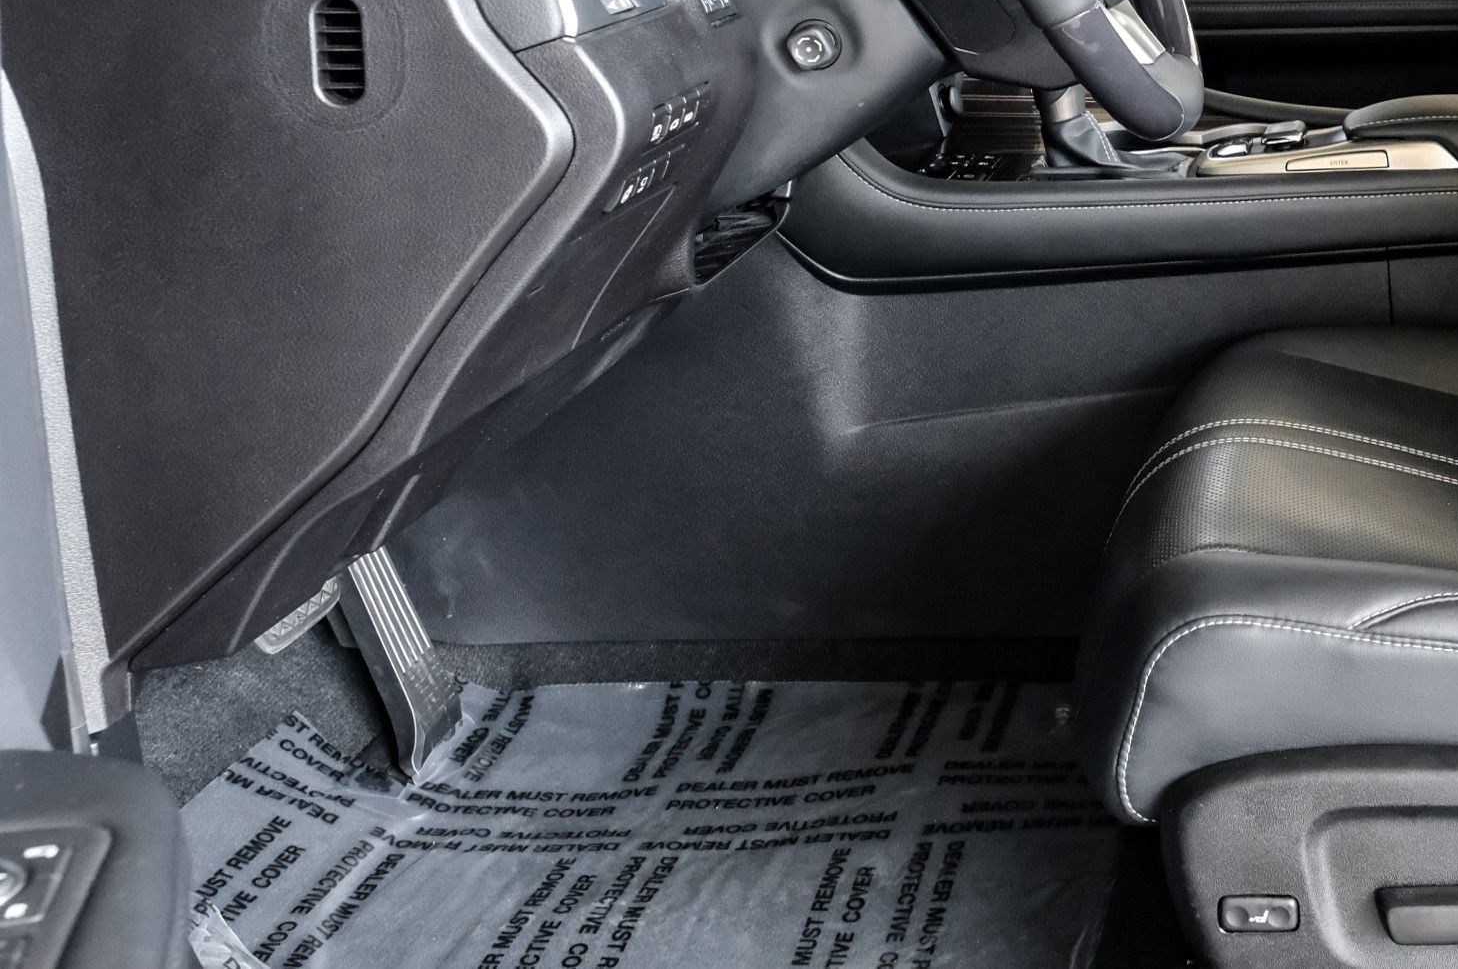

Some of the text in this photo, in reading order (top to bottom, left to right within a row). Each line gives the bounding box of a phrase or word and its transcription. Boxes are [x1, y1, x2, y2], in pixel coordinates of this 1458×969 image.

[506, 695, 534, 735] MUST
[239, 756, 357, 809] PROTECTIV
[279, 739, 345, 783] COVER
[676, 763, 915, 793] DEALER MUST REMOVE
[218, 768, 340, 826] DEALER MU
[405, 792, 616, 818] PROTECTIVE COVER
[418, 781, 660, 802] DEALER MUST REMOVE
[665, 785, 876, 811] PROTECTIVE COVER
[961, 800, 1037, 813] COVER
[225, 815, 292, 871] REMOVE
[415, 827, 632, 840] PROTECTIVE COVER
[533, 840, 621, 852] DEALER
[637, 830, 892, 852] DEALER MUST REMOVE
[682, 811, 898, 836] PROTECTIVE COVER
[921, 819, 1014, 836] REMOVE
[251, 844, 306, 889] COVER
[463, 840, 531, 853] MUST
[553, 874, 598, 914] COVER
[633, 856, 679, 904] DEALER
[885, 841, 934, 944] PROTECTIVE
[931, 840, 967, 903] DEALER
[250, 839, 374, 964] PROTECTIVE COVE
[283, 853, 405, 969] DEALER MUST REM
[491, 909, 535, 950] MUST
[523, 857, 577, 907] REMOVE
[579, 855, 648, 935] PROTECTIVE
[790, 916, 825, 967] MUST
[810, 847, 852, 912] REMOVE
[842, 865, 877, 924] COVER
[608, 905, 647, 952] MUST
[918, 906, 948, 956] MUST
